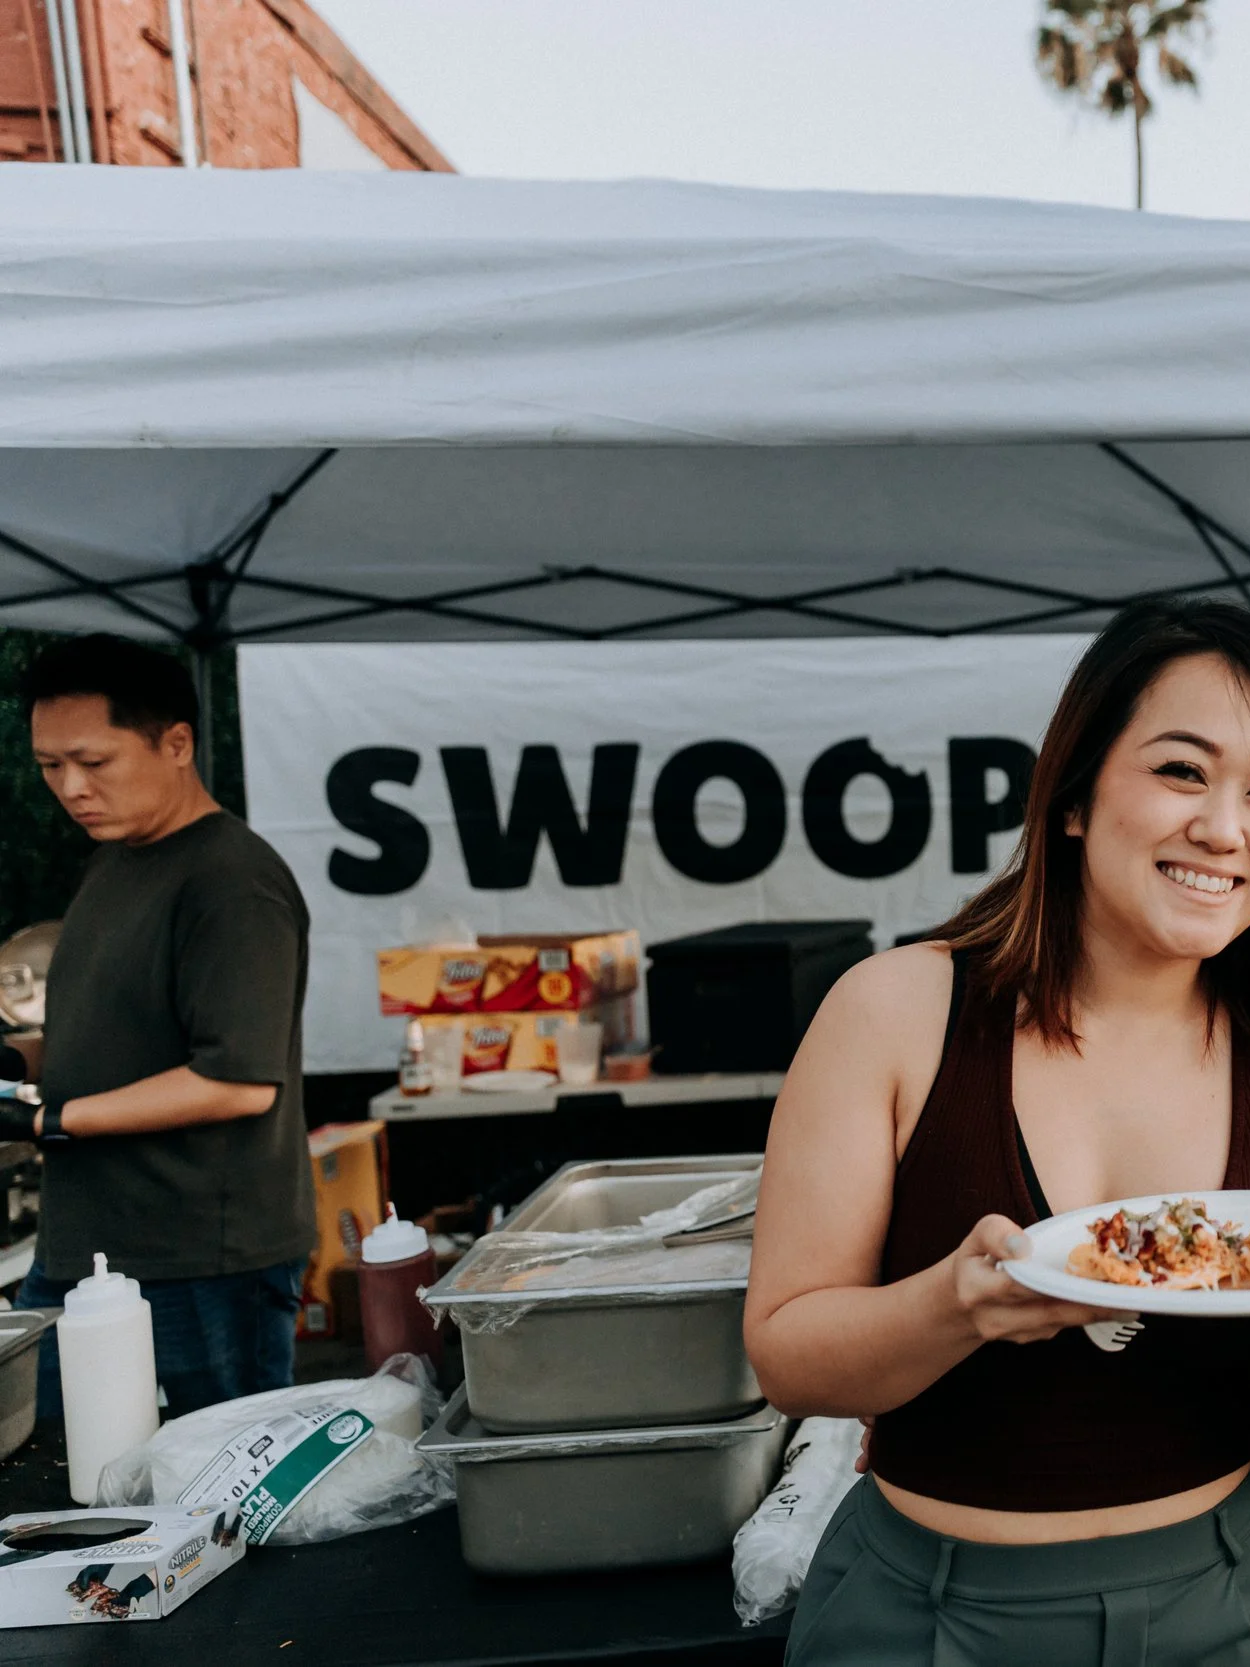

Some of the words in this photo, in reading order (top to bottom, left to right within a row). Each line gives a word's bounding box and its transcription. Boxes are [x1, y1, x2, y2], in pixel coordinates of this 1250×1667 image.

[326, 736, 1038, 896] SWOOP
[264, 1454, 275, 1466] 7
[232, 1479, 250, 1498] 10
[247, 1496, 278, 1529] MOLDED
[79, 1544, 156, 1558] NITRILE
[171, 1536, 206, 1569] NITRILE
